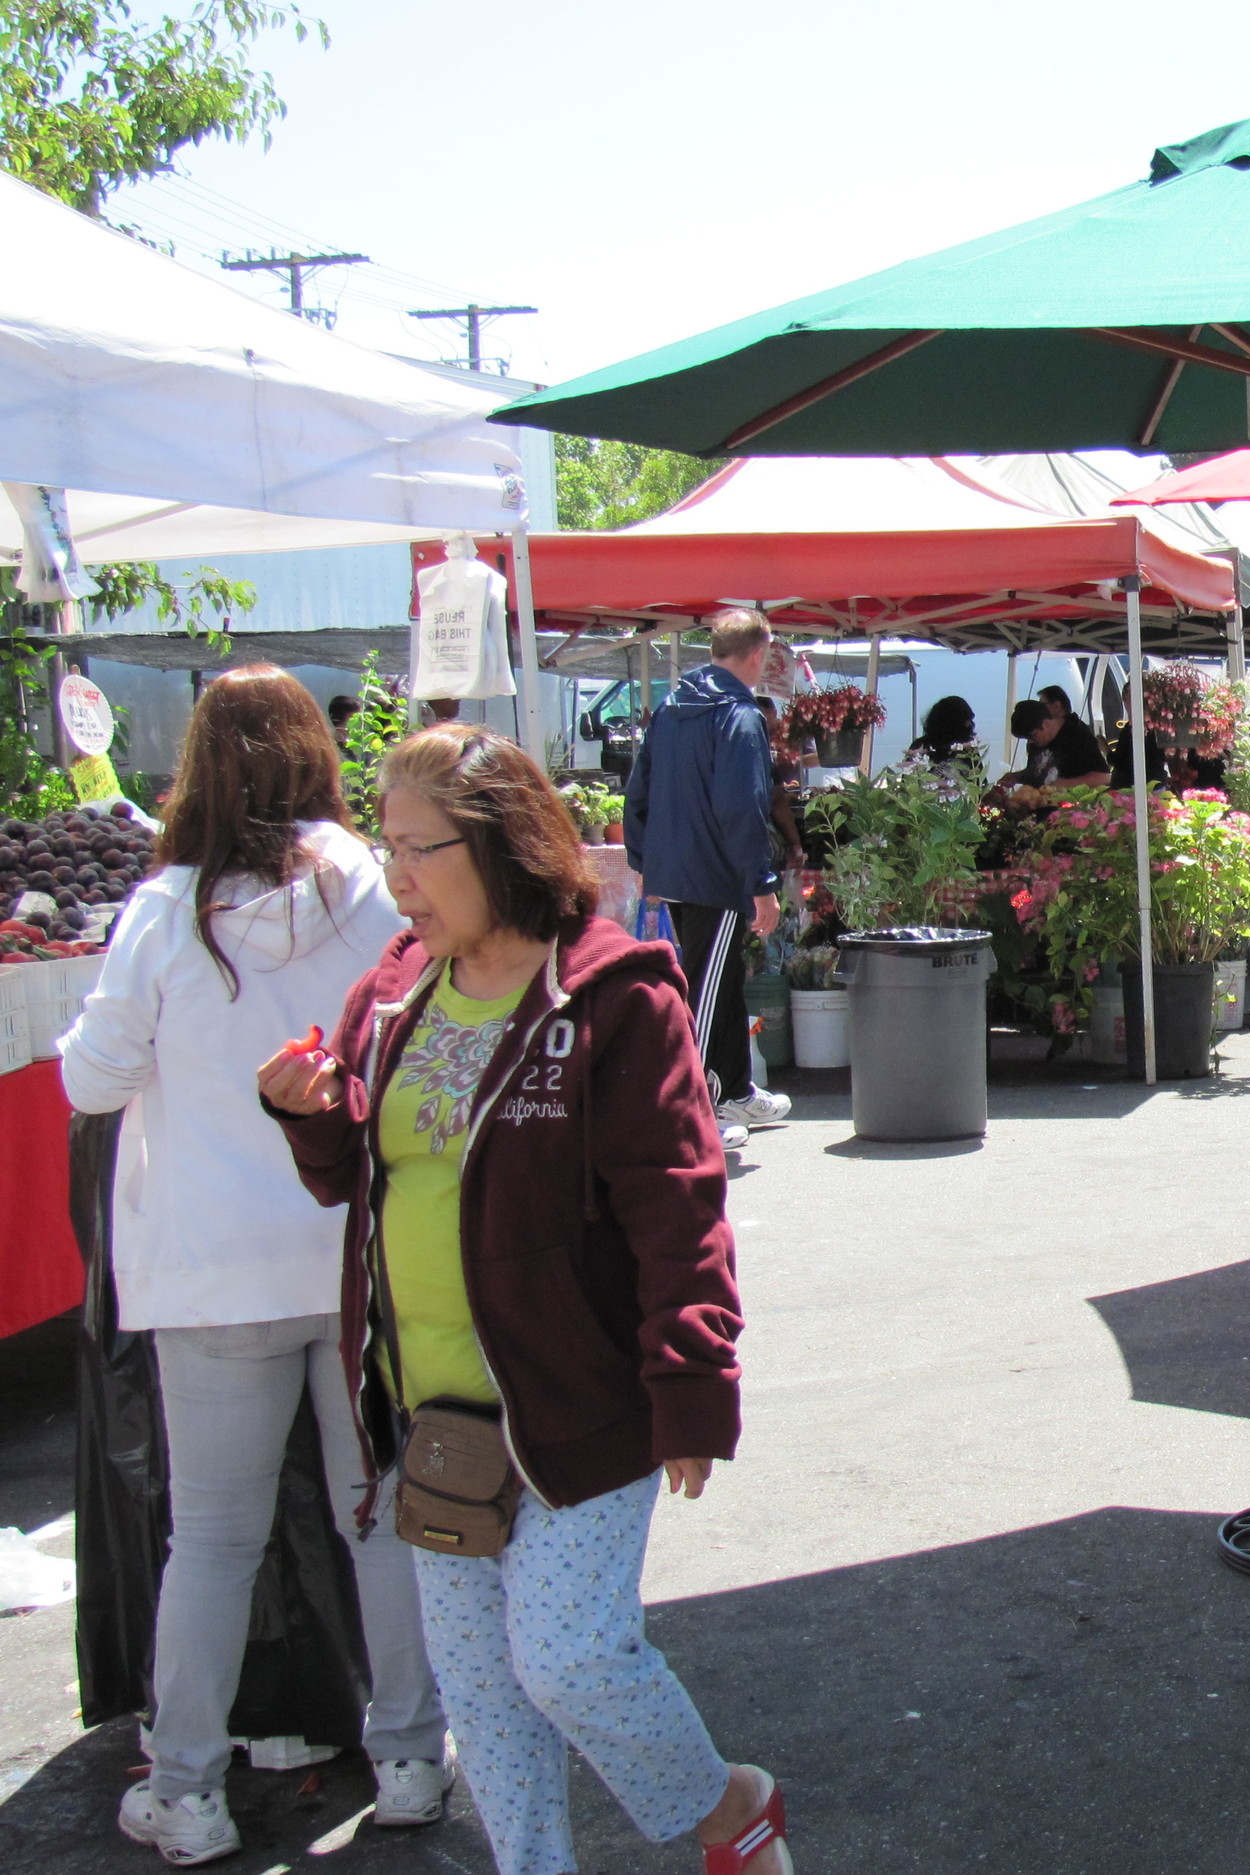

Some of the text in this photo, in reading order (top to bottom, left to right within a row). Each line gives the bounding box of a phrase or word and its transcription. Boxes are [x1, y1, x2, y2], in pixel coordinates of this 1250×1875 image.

[932, 952, 978, 968] BRUTE
[522, 1065, 563, 1091] 22
[498, 1096, 569, 1127] lifornia
